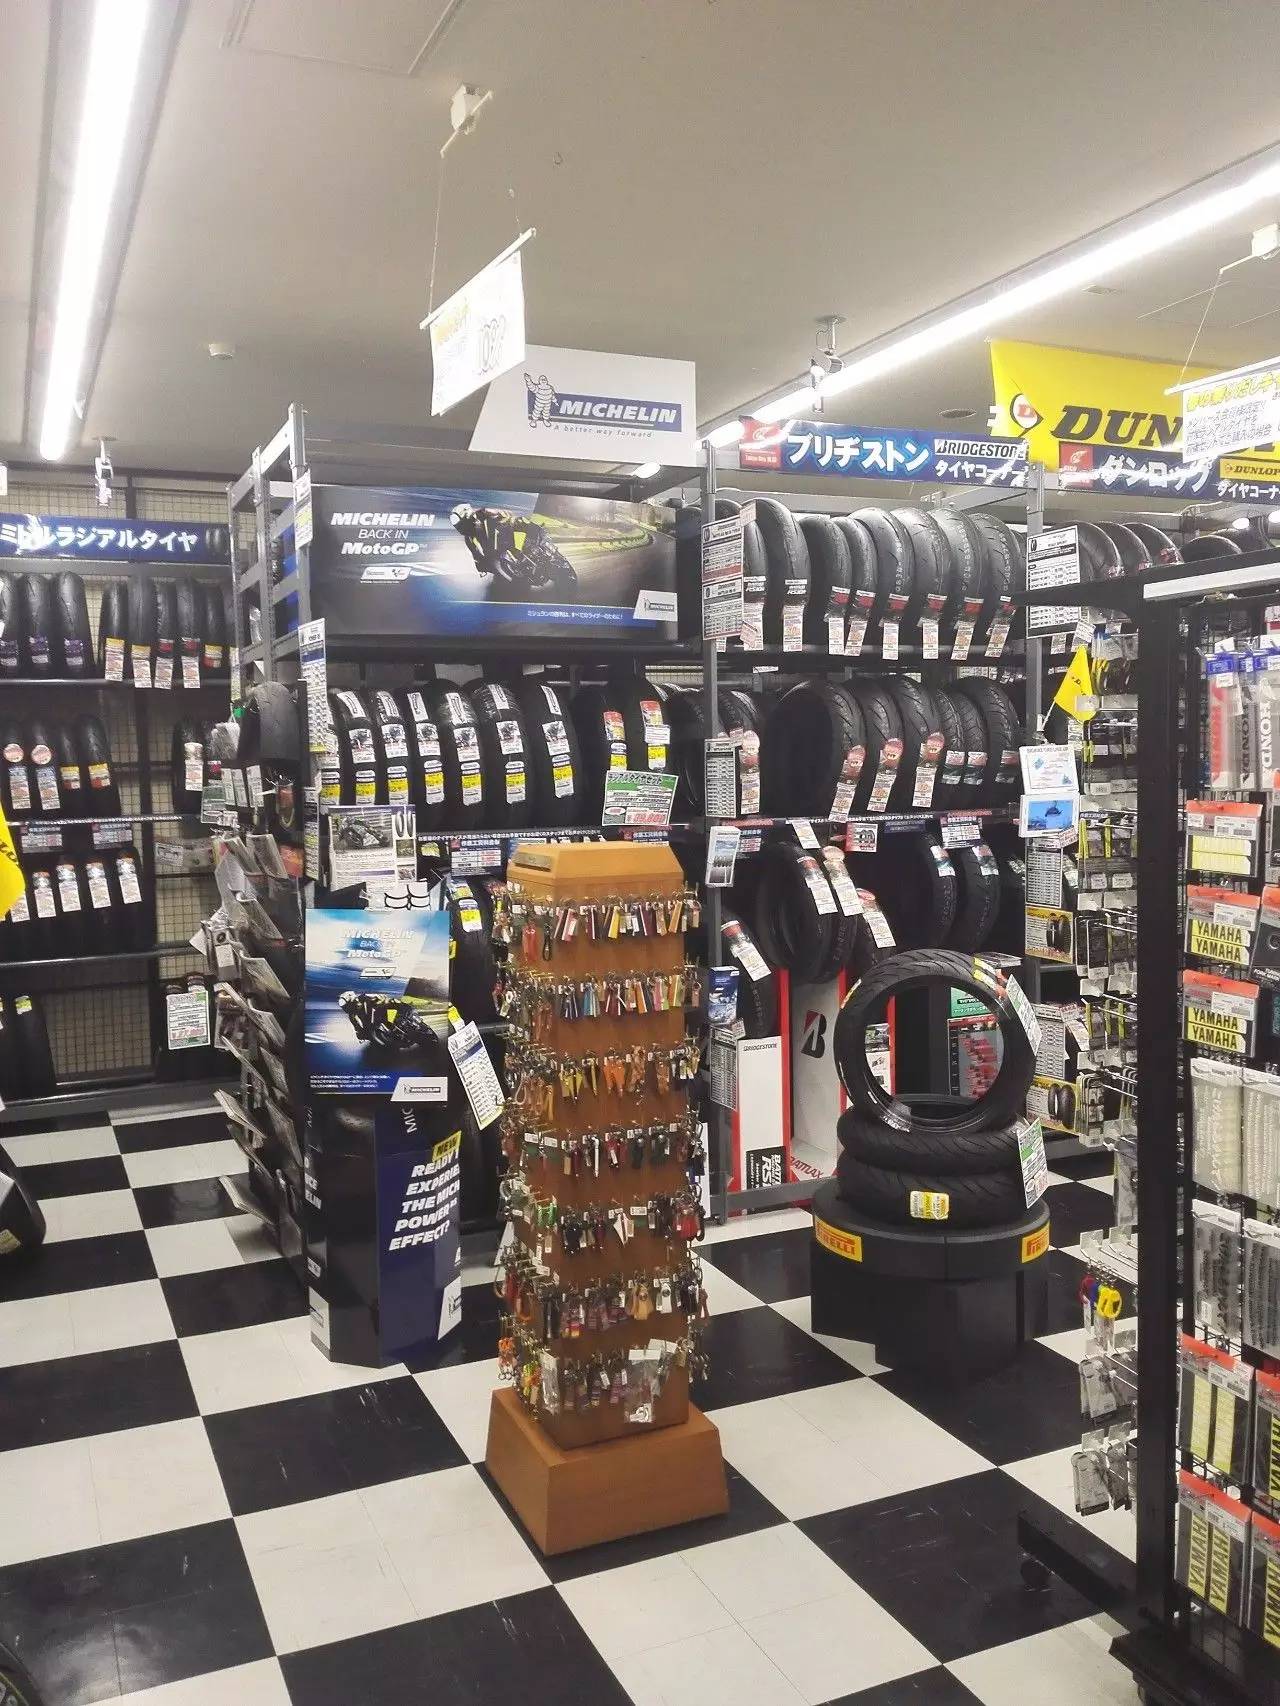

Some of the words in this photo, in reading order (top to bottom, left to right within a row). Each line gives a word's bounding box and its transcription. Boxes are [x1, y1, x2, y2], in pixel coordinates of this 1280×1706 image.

[559, 400, 677, 423] MICHELIN
[564, 426, 592, 434] better
[617, 429, 652, 438] forward
[787, 433, 929, 472] ブリヂストン
[1217, 478, 1280, 500] タイヤコーナ
[330, 512, 436, 527] MICHELIN
[358, 529, 392, 539] BACK
[395, 529, 409, 539] IN
[342, 927, 416, 939] MICHELIN
[1197, 919, 1243, 944] YAMAHA
[1195, 937, 1242, 962] YAMAHA
[1192, 1008, 1238, 1031] YAMAHA
[1191, 1024, 1238, 1050] YAMAHA
[437, 1137, 457, 1157] NEW
[402, 1195, 436, 1214] THE
[395, 1205, 449, 1233] POWER
[389, 1220, 449, 1251] EFFECT?
